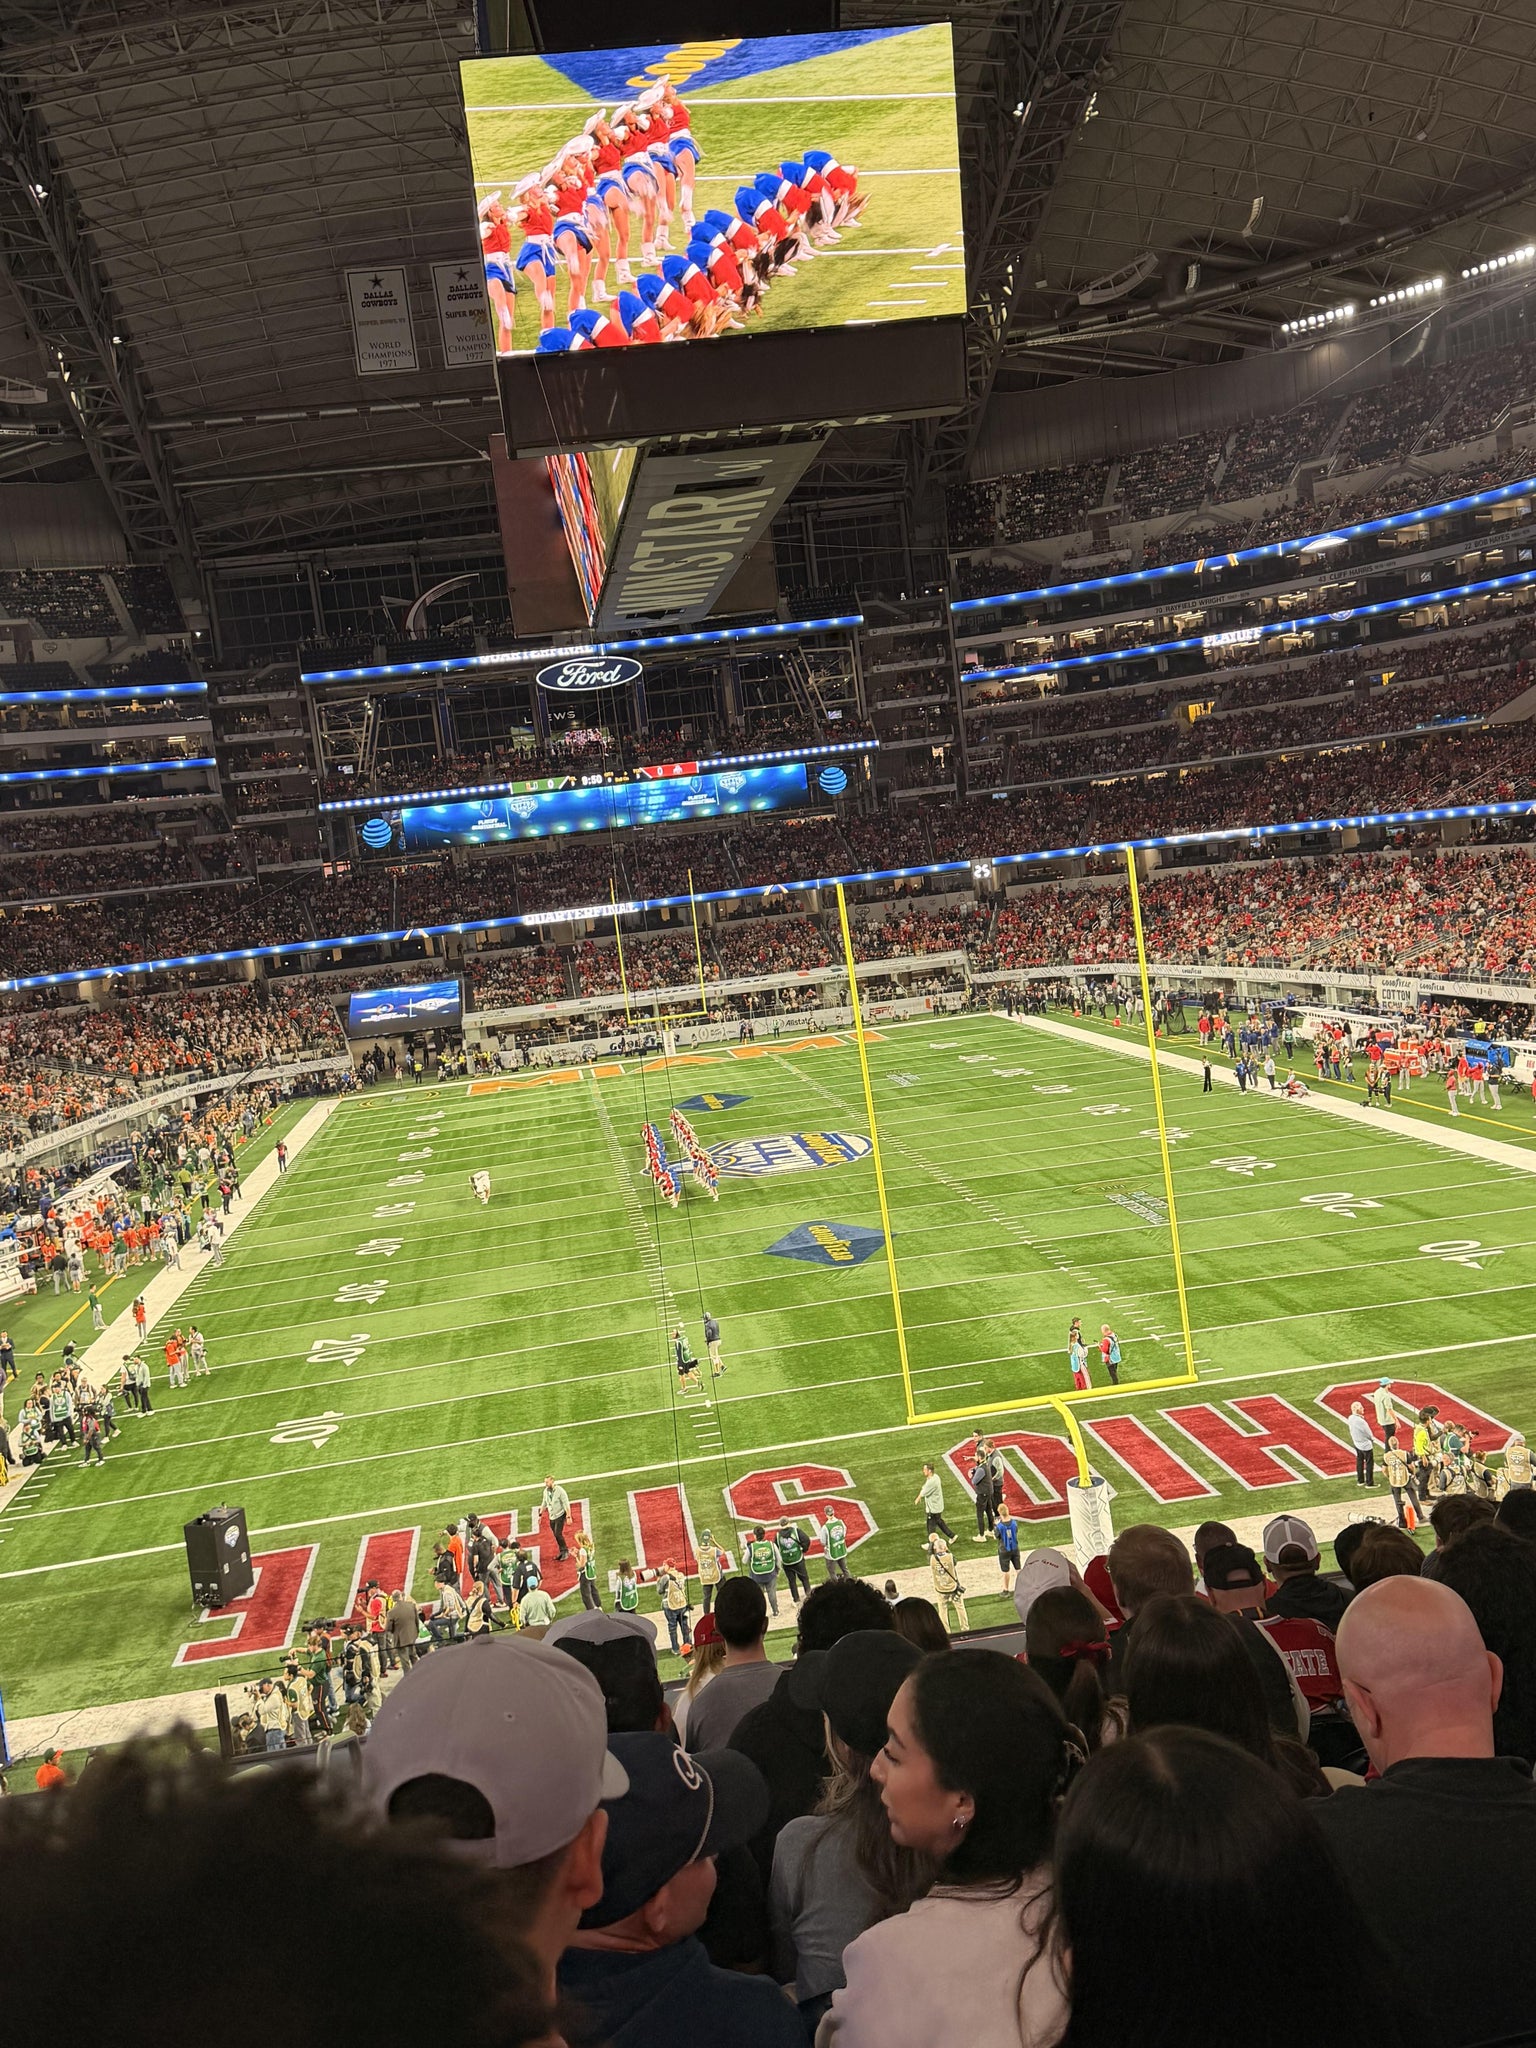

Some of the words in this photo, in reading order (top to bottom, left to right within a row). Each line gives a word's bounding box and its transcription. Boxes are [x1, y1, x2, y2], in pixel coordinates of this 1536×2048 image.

[364, 290, 394, 300] DALLAS
[447, 291, 483, 301] COWBOYS
[449, 283, 479, 293] DALLAS
[361, 299, 398, 308] COWBOYS
[445, 310, 468, 319] SUPER
[468, 308, 487, 318] BOW
[369, 341, 401, 350] WORLD
[455, 333, 487, 343] WORLD
[361, 350, 413, 360] CHAMPIONS
[448, 343, 492, 353] CHAMPION
[379, 360, 397, 368] 1971
[466, 352, 484, 361] 1977
[1474, 539, 1488, 548] BOB
[1488, 533, 1511, 545] HAYES
[614, 487, 776, 616] WINSTAR
[1329, 570, 1349, 581] CLIFF
[1349, 566, 1374, 577] HARRIS
[1165, 601, 1197, 613] RAYFIELD
[1199, 596, 1225, 606] WRIGHT
[1203, 628, 1262, 647] PLAYOFF
[556, 661, 622, 687] Ford
[524, 711, 576, 724] LEWS
[974, 863, 991, 878] 25
[524, 902, 640, 926] QUARTERFINAL
[1382, 989, 1411, 1001] COTTON
[1420, 983, 1445, 991] GOODYEAR
[466, 1030, 889, 1096] MIAMI
[1081, 1103, 1132, 1115] 50
[800, 1133, 849, 1164] GOODYEAR
[1209, 1156, 1277, 1173] 30
[371, 1201, 416, 1218] 50
[1299, 1192, 1385, 1213] 20
[808, 1224, 855, 1261] GOODYEAR
[1418, 1240, 1505, 1262] 10
[333, 1279, 390, 1303] 30
[306, 1333, 371, 1363] 20
[269, 1410, 345, 1444] 10
[941, 1379, 1521, 1523] OHIO
[173, 1462, 880, 1668] STATE
[1282, 1649, 1332, 1677] ATE
